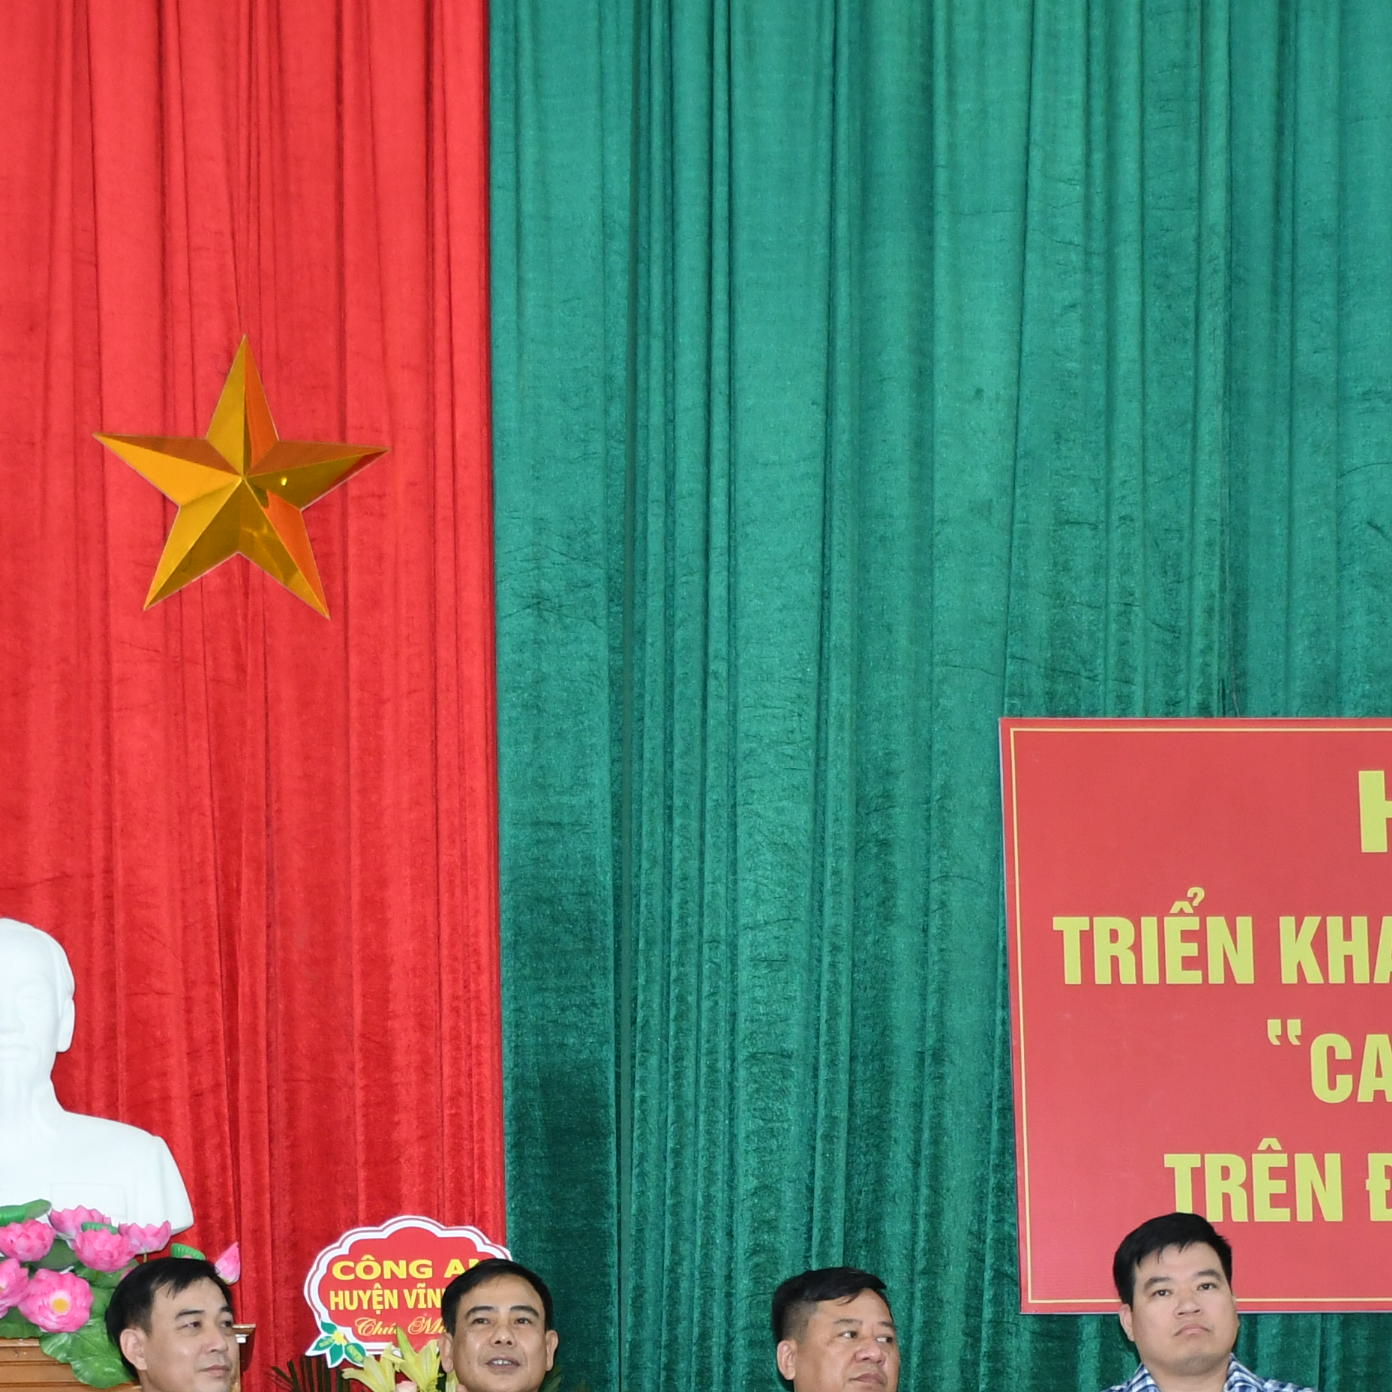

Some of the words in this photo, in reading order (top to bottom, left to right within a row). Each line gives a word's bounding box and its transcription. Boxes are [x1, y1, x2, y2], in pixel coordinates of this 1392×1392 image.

[1053, 887, 1255, 985] TRIỂN
[1164, 1138, 1343, 1223] TRÊN
[331, 1255, 433, 1280] CÔNG
[444, 1258, 479, 1279] A
[329, 1283, 399, 1315] HUYỆN
[403, 1283, 446, 1309] VĨN
